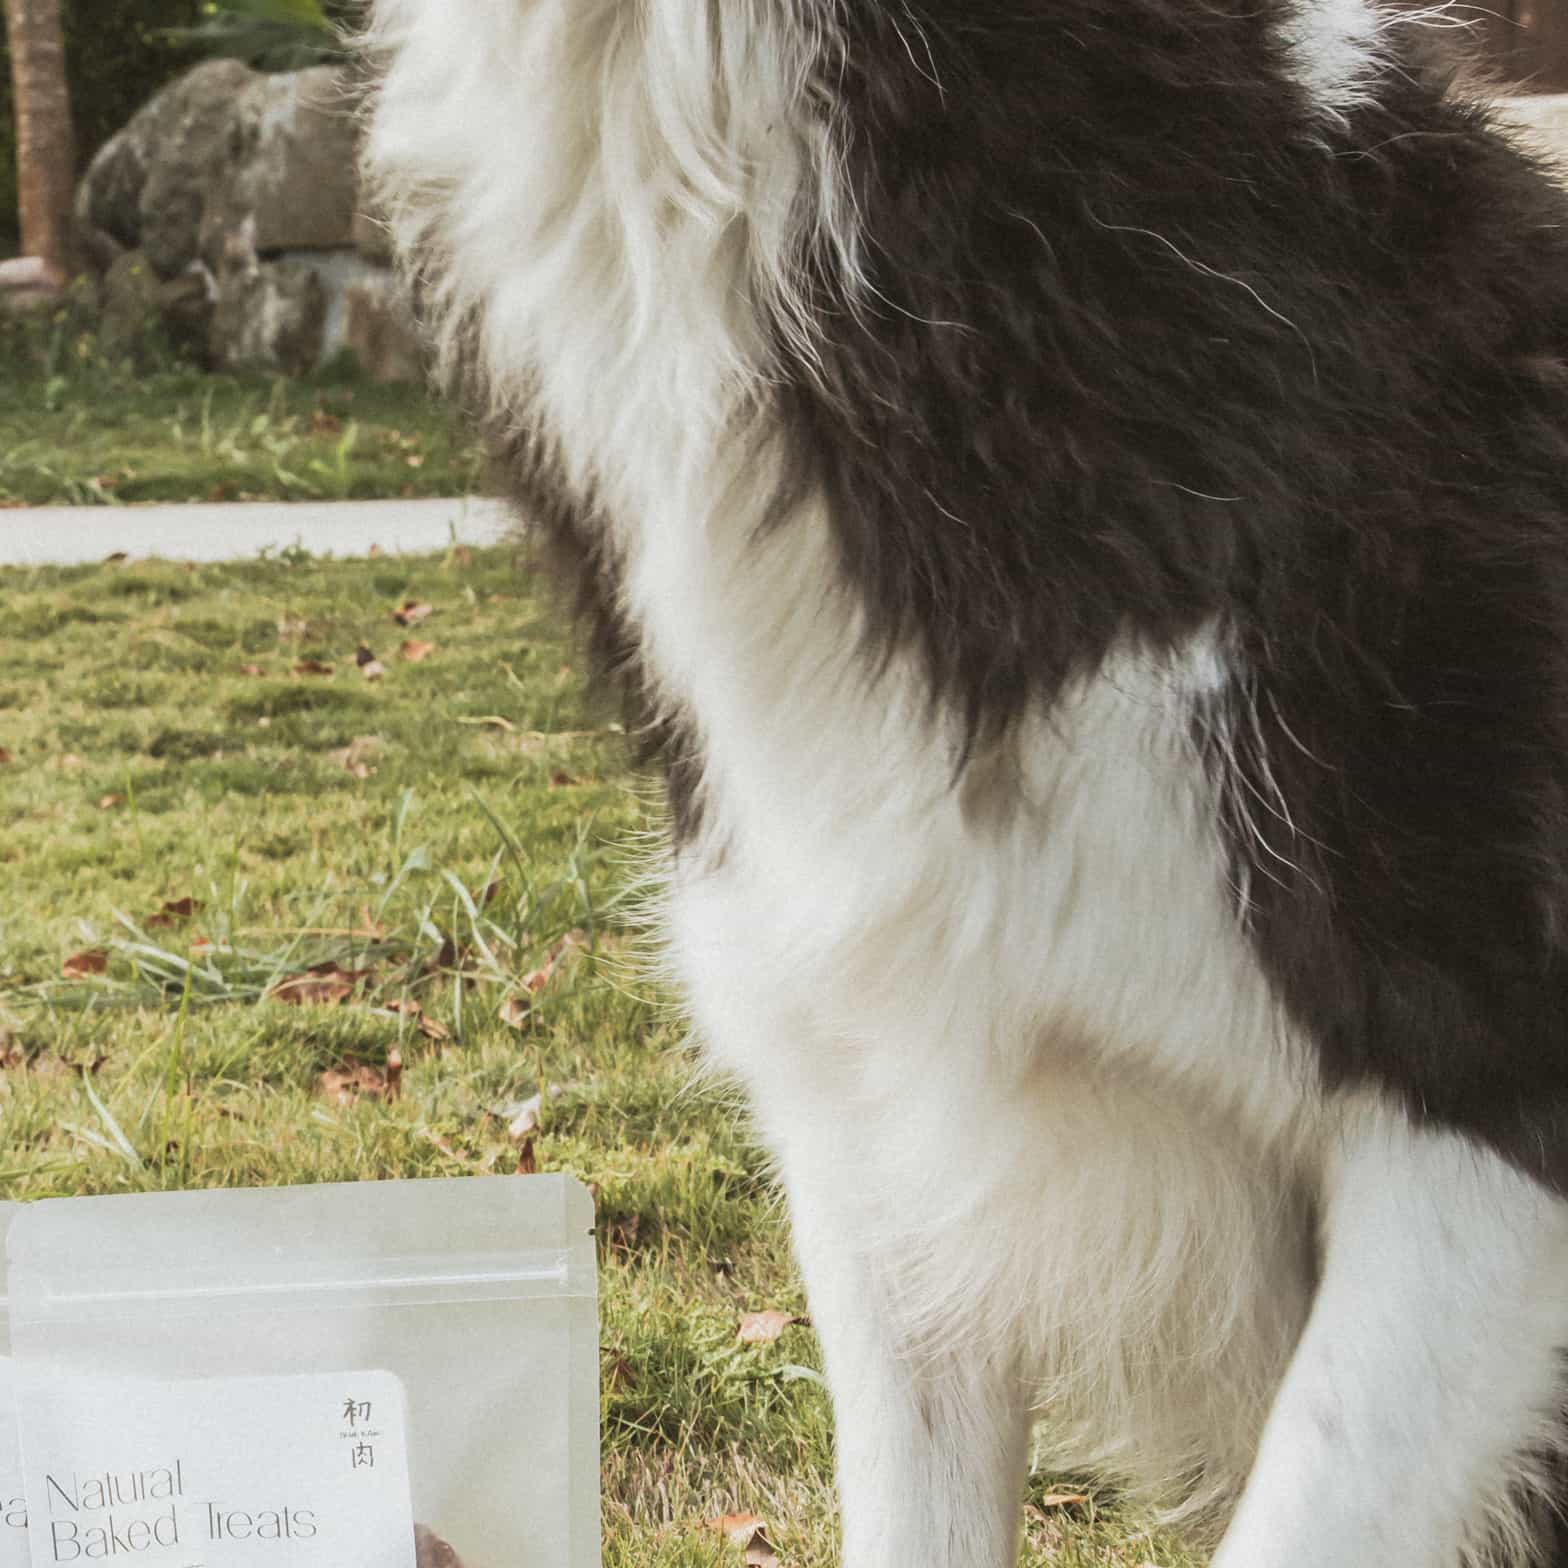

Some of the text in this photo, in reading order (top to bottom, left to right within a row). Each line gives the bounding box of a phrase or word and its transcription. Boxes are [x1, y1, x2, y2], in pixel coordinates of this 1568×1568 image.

[343, 1397, 372, 1428] 初
[351, 1441, 374, 1469] 肉
[46, 1459, 184, 1513] Natural
[51, 1501, 318, 1562] Baked Treats
